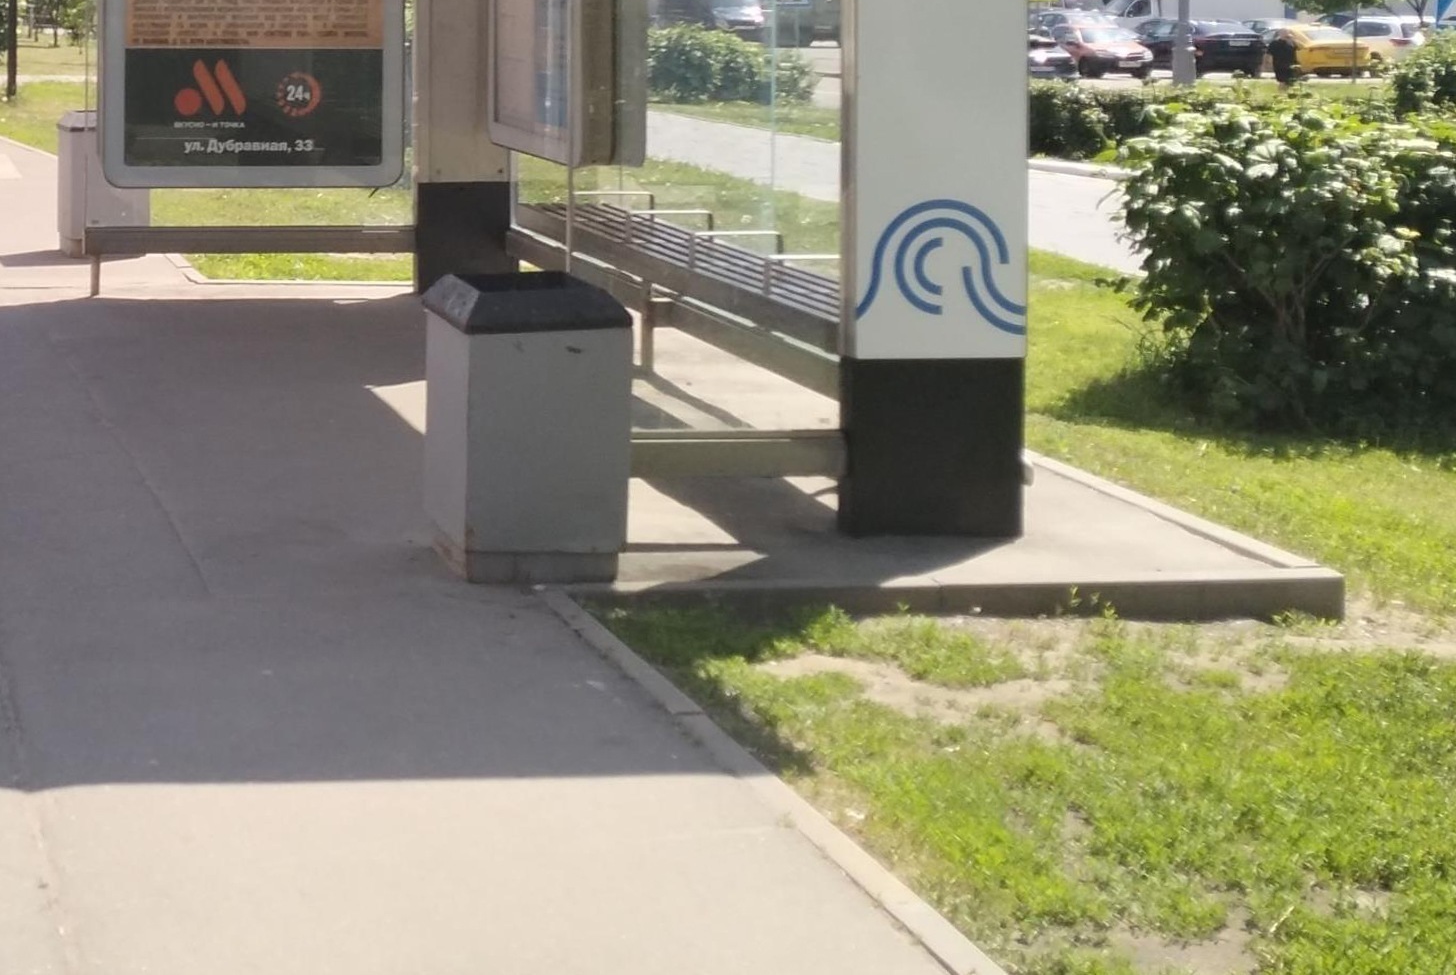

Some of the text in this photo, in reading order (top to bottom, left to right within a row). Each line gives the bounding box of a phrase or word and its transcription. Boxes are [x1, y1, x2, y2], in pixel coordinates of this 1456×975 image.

[183, 138, 314, 154] ул. Дубравная, 33
